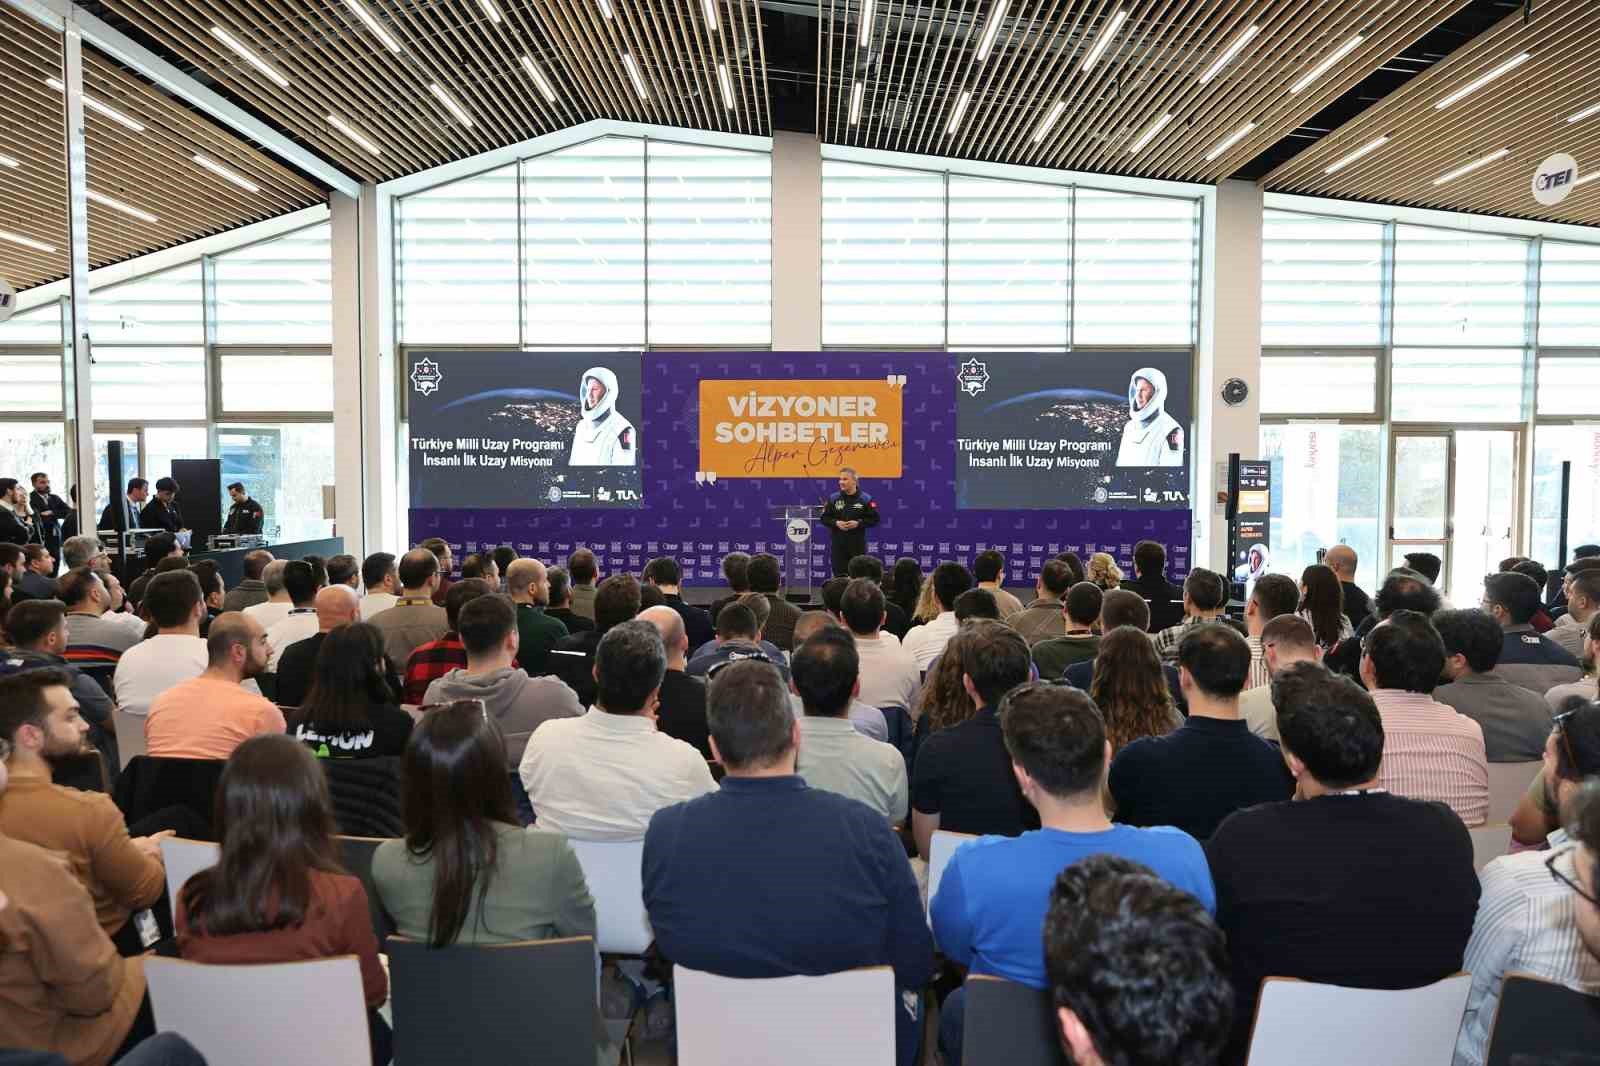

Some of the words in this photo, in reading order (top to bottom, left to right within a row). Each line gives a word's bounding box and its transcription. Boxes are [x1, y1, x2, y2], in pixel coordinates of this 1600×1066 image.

[727, 391, 878, 418] VİZYONER
[714, 422, 889, 444] SOHBETLER
[411, 437, 453, 453] Türkiye
[481, 438, 510, 453] Uzay
[513, 438, 565, 453] Programı
[957, 437, 1000, 453] Türkiye
[1029, 439, 1056, 453] Uzay
[1059, 439, 1112, 453] Programı
[423, 452, 461, 467] İnsanlı
[463, 452, 477, 467] İlk
[480, 455, 508, 469] Uzay
[510, 455, 553, 469] Misyonu
[744, 438, 799, 473] Alper
[969, 452, 1007, 467] İnsanlı
[1009, 453, 1023, 467] İlk
[1026, 455, 1054, 469] Uzay
[1057, 455, 1100, 469] Misyonu
